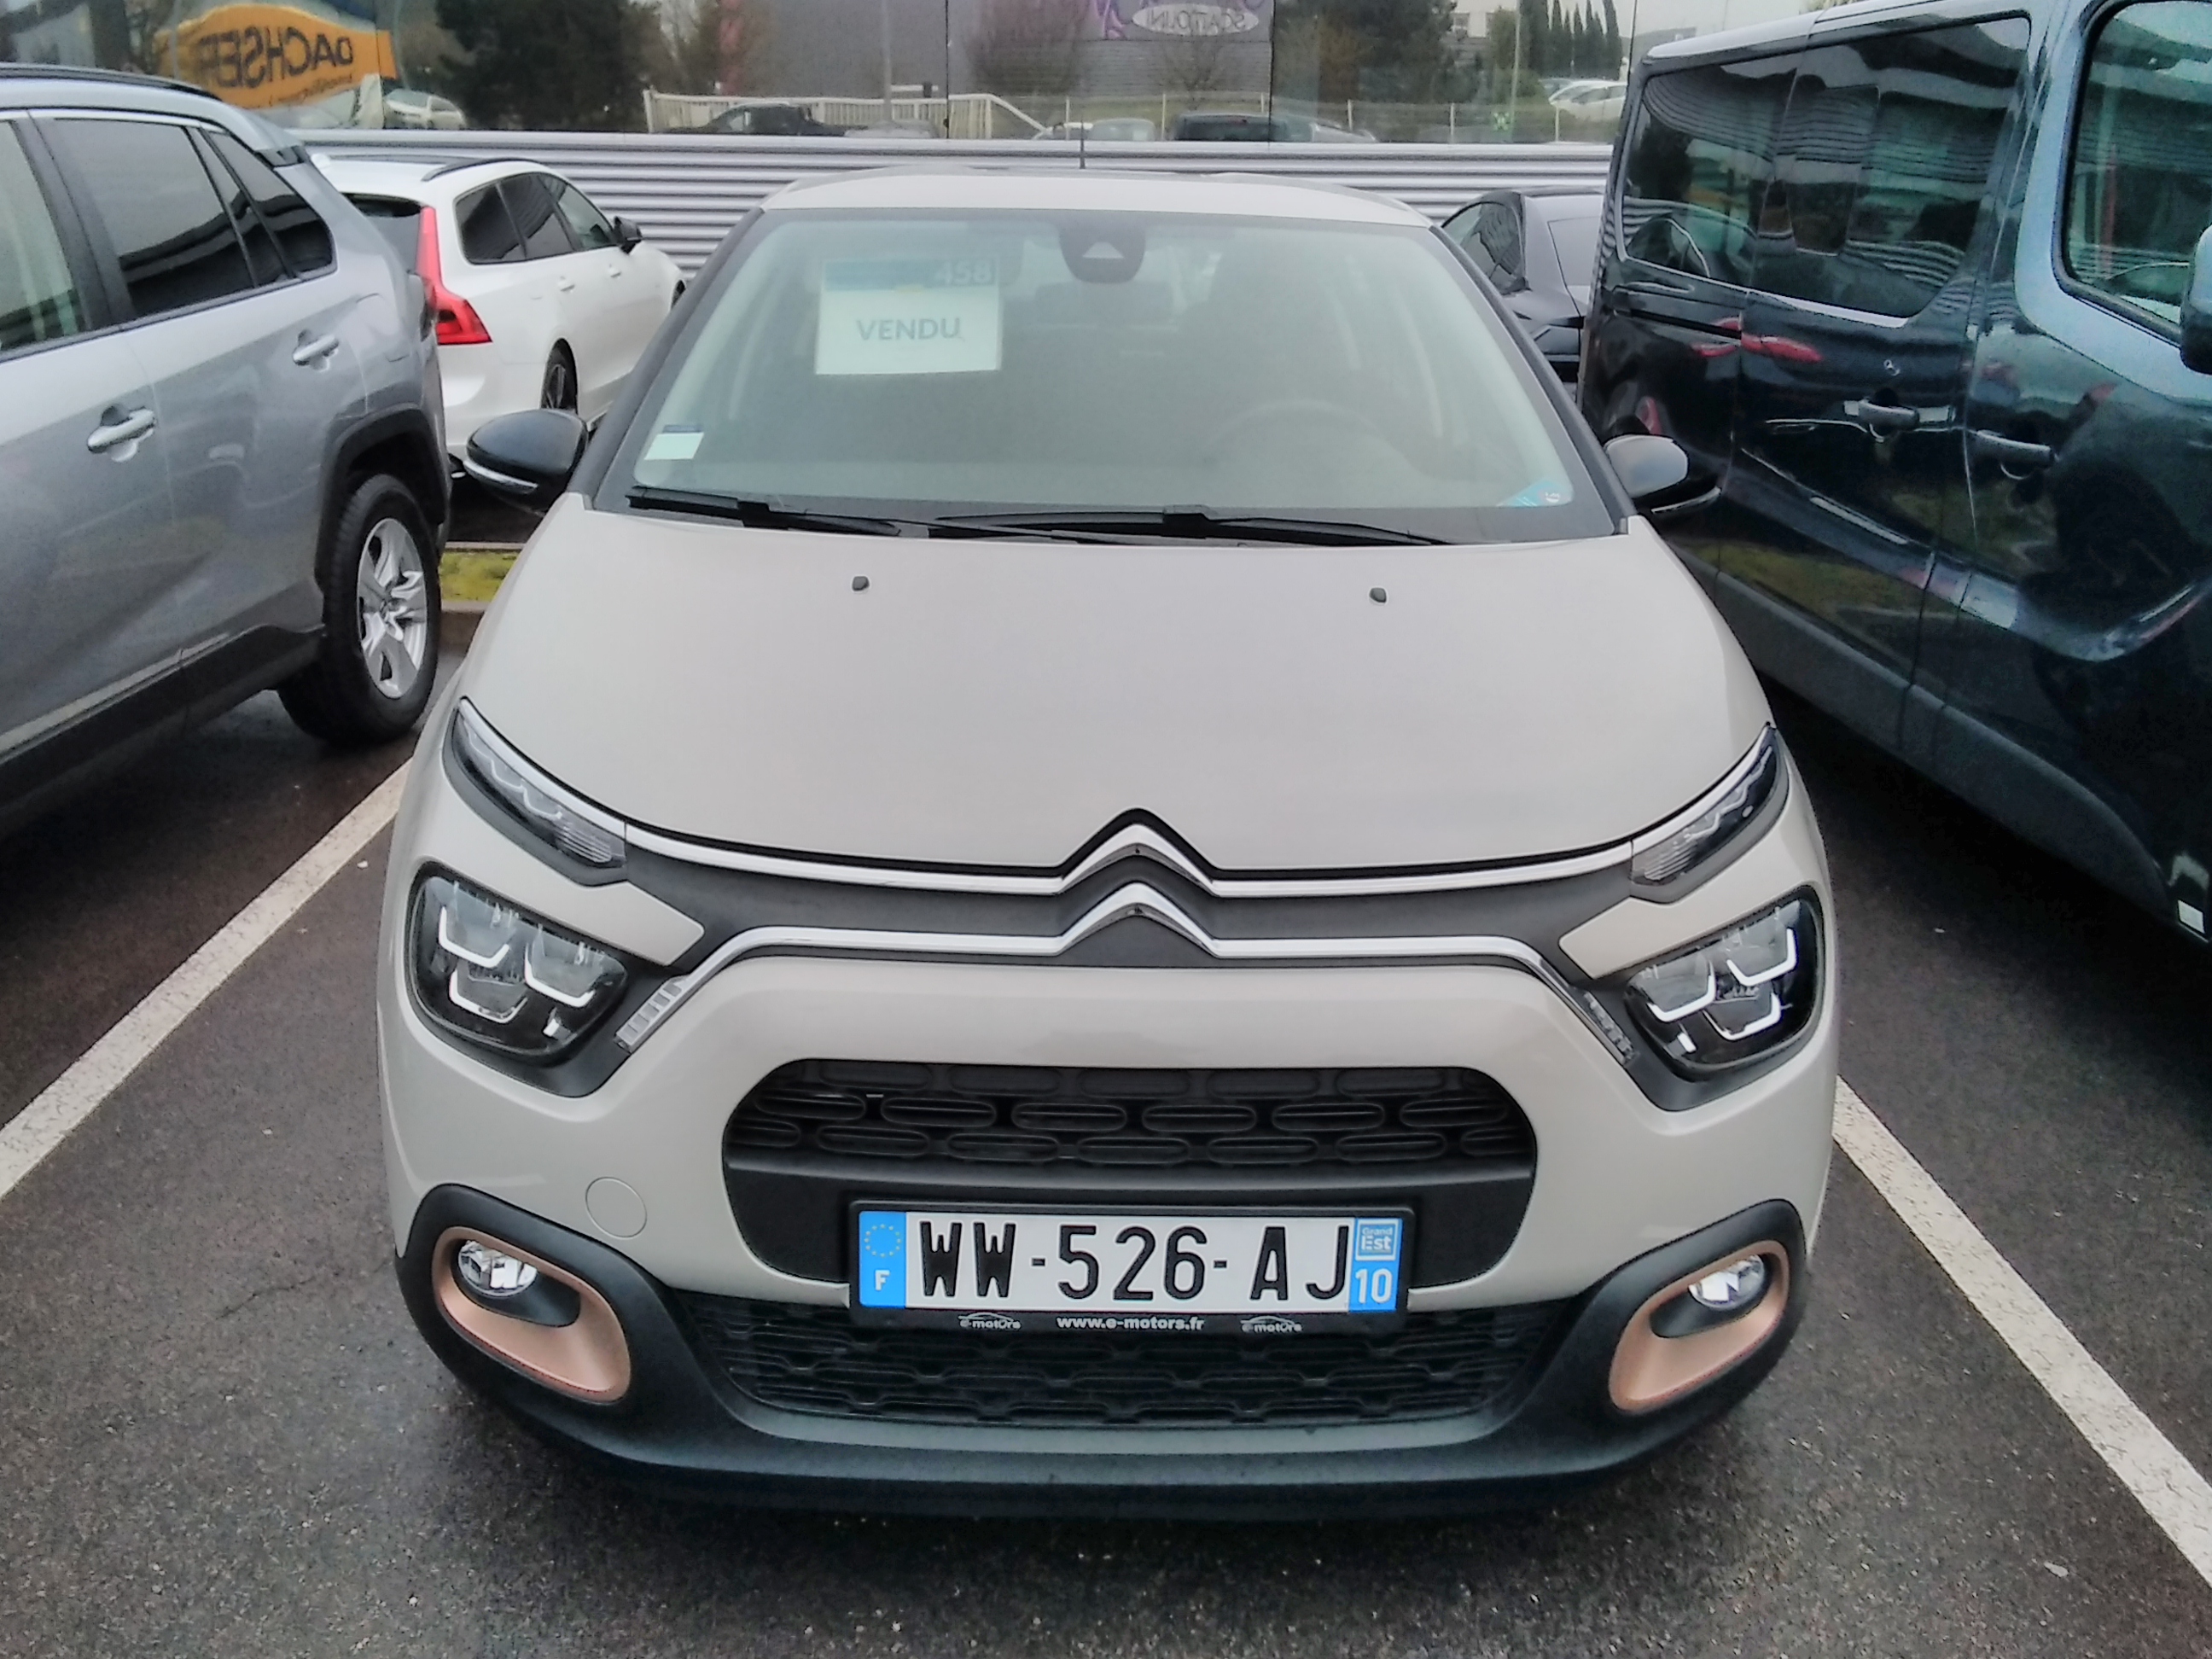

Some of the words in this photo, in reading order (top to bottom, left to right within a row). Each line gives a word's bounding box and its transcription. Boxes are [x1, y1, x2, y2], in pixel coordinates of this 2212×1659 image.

[856, 317, 961, 341] VENDU
[1360, 1235, 1392, 1251] Est
[874, 1269, 891, 1291] F
[1354, 1268, 1393, 1305] 10
[1056, 1315, 1205, 1331] www.e-motors.fr
